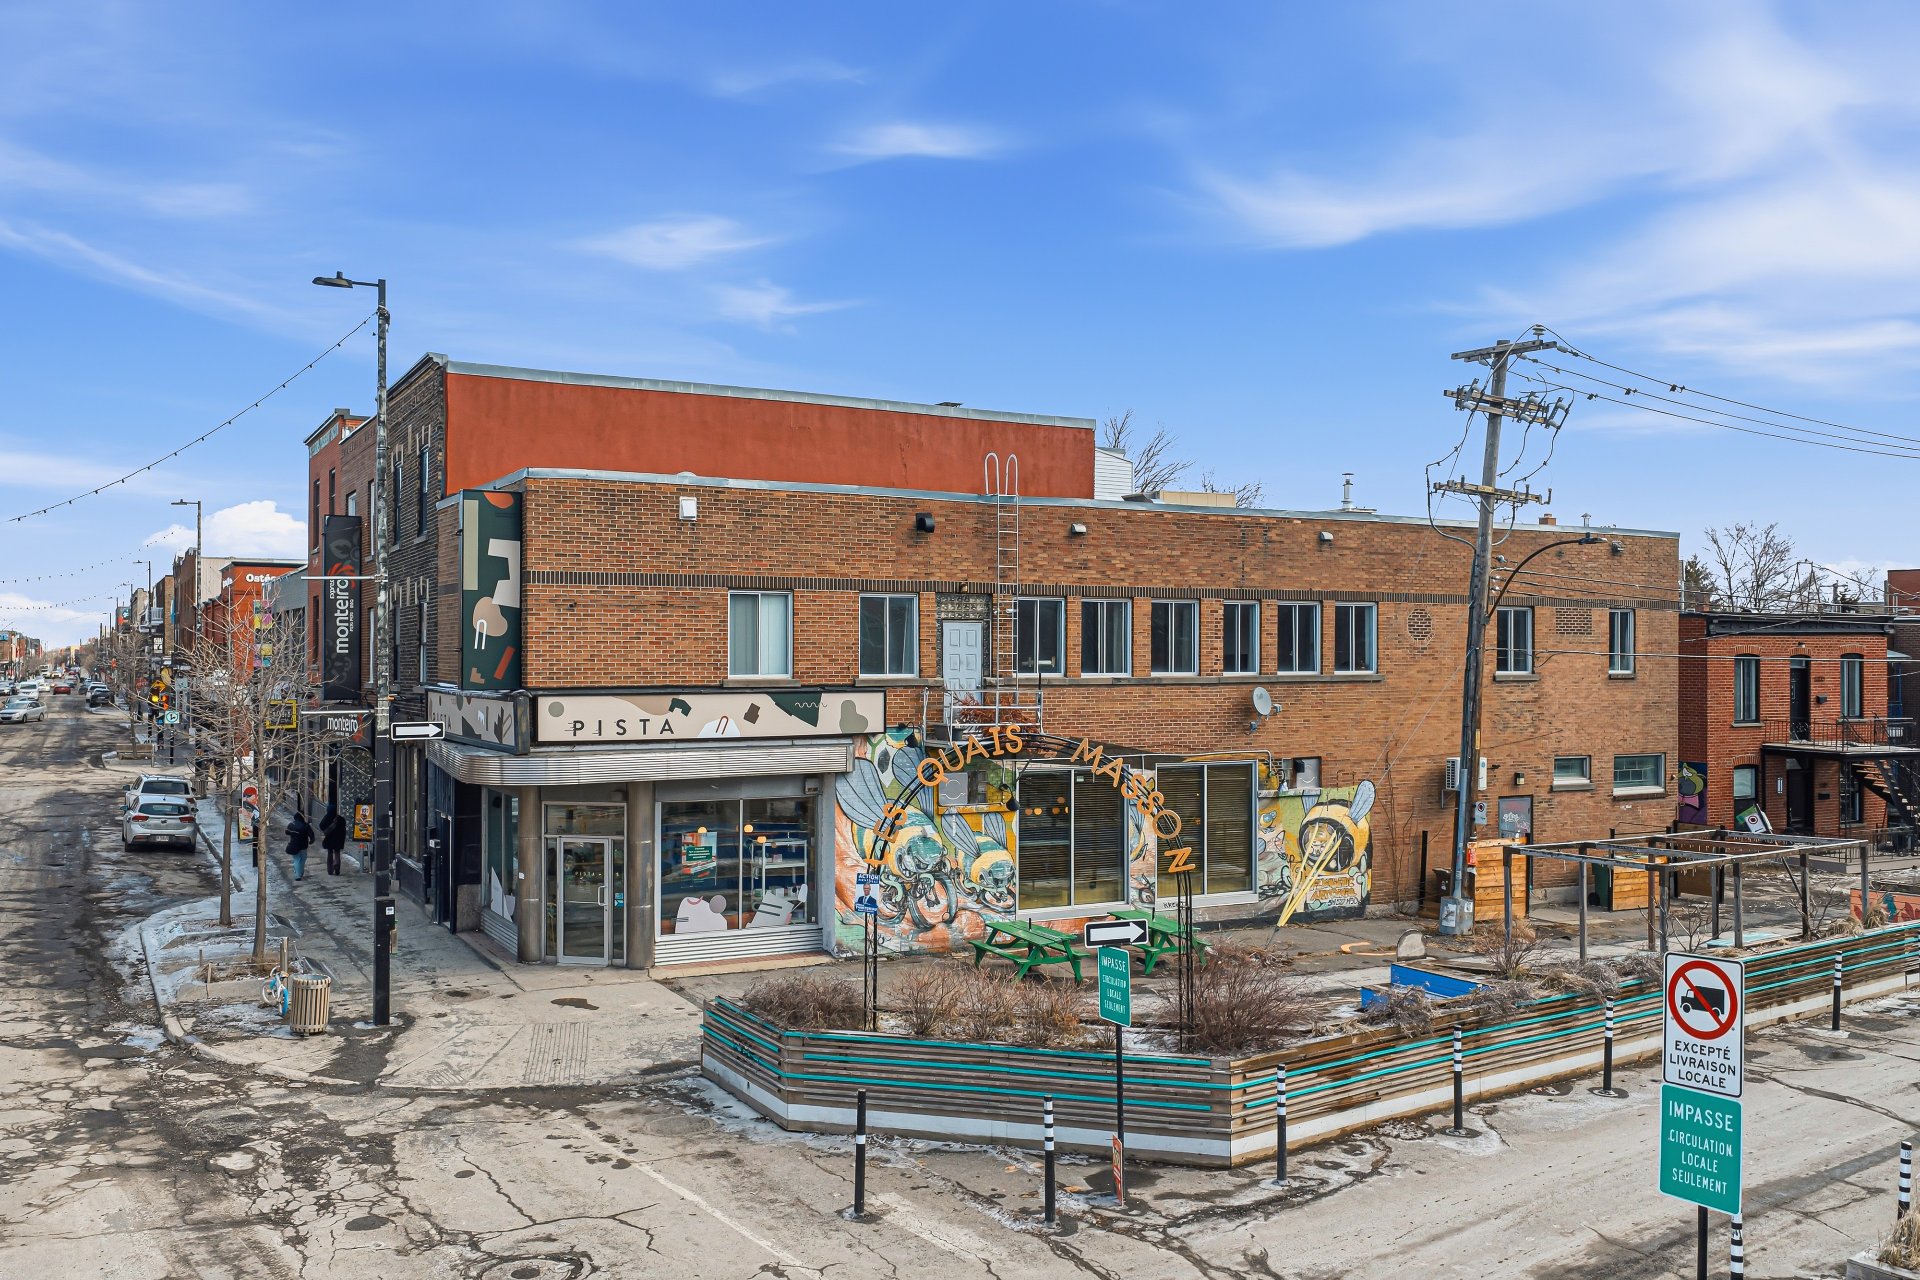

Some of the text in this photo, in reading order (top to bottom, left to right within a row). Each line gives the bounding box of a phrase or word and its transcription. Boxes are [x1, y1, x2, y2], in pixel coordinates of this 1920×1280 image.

[334, 579, 349, 654] monteiro
[327, 716, 359, 732] monteiro
[572, 718, 675, 737] PISTA
[863, 724, 1196, 873] LES QUAIS MASSON
[1101, 956, 1126, 973] IMPASSE
[1102, 974, 1127, 989] CIRCULATION
[1106, 988, 1122, 1001] LOCALE
[1104, 999, 1126, 1014] SEULEMENT
[1674, 1040, 1731, 1061] EXCEPTÉ
[1669, 1053, 1736, 1077] LIVRAISON
[1678, 1069, 1727, 1088] LOCALE
[1669, 1100, 1734, 1132] IMPASSE
[1669, 1129, 1733, 1157] CIRCULATION
[1681, 1151, 1718, 1173] LOCALE
[1672, 1167, 1728, 1195] SEULEMENT
